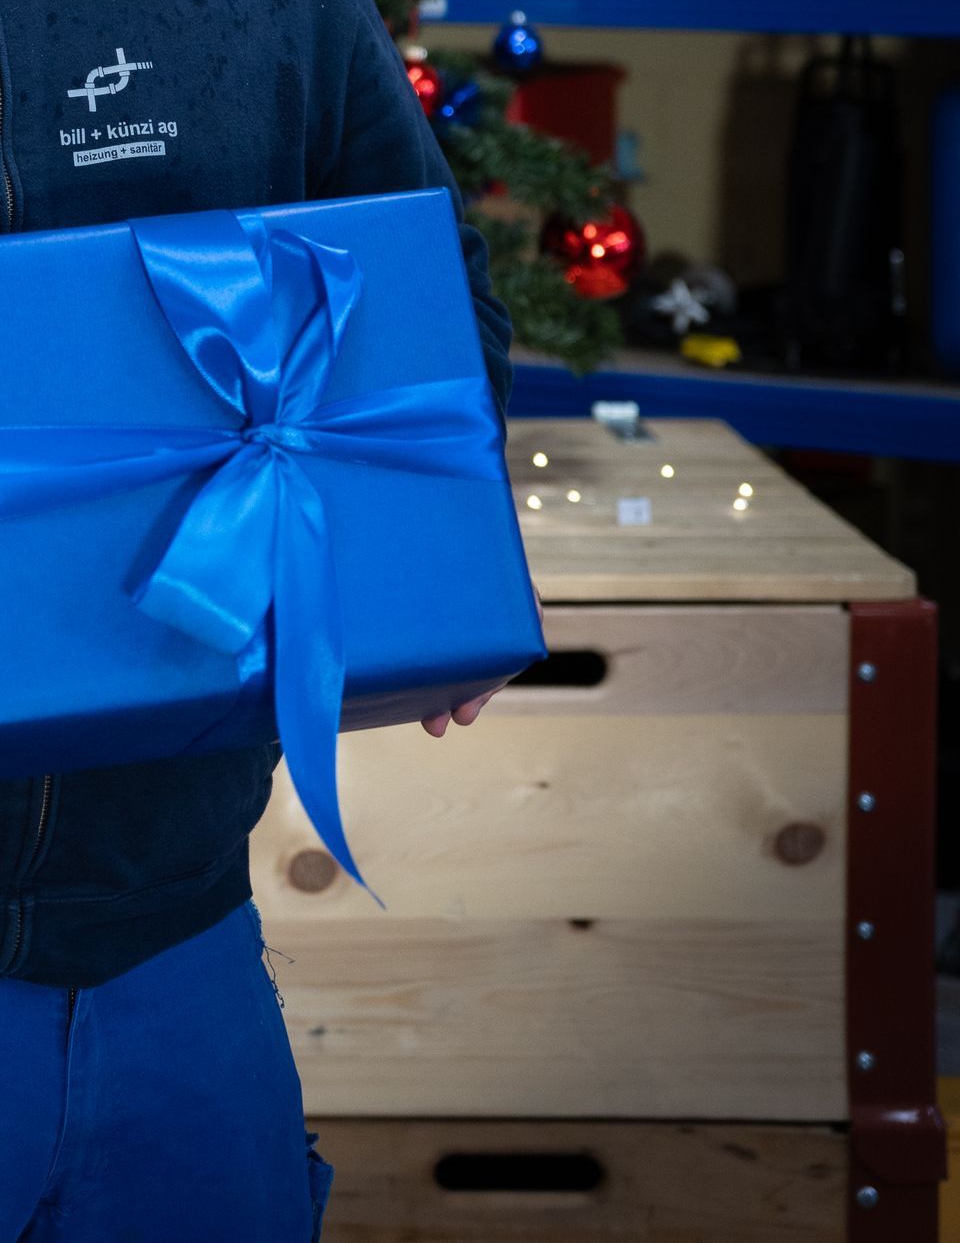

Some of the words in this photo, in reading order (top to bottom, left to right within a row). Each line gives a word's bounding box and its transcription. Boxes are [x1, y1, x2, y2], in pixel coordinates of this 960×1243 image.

[60, 128, 85, 145] bill
[91, 129, 101, 140] +
[107, 119, 154, 139] künzi
[158, 121, 178, 137] ag
[76, 149, 118, 163] heizung
[130, 143, 162, 154] sanitär
